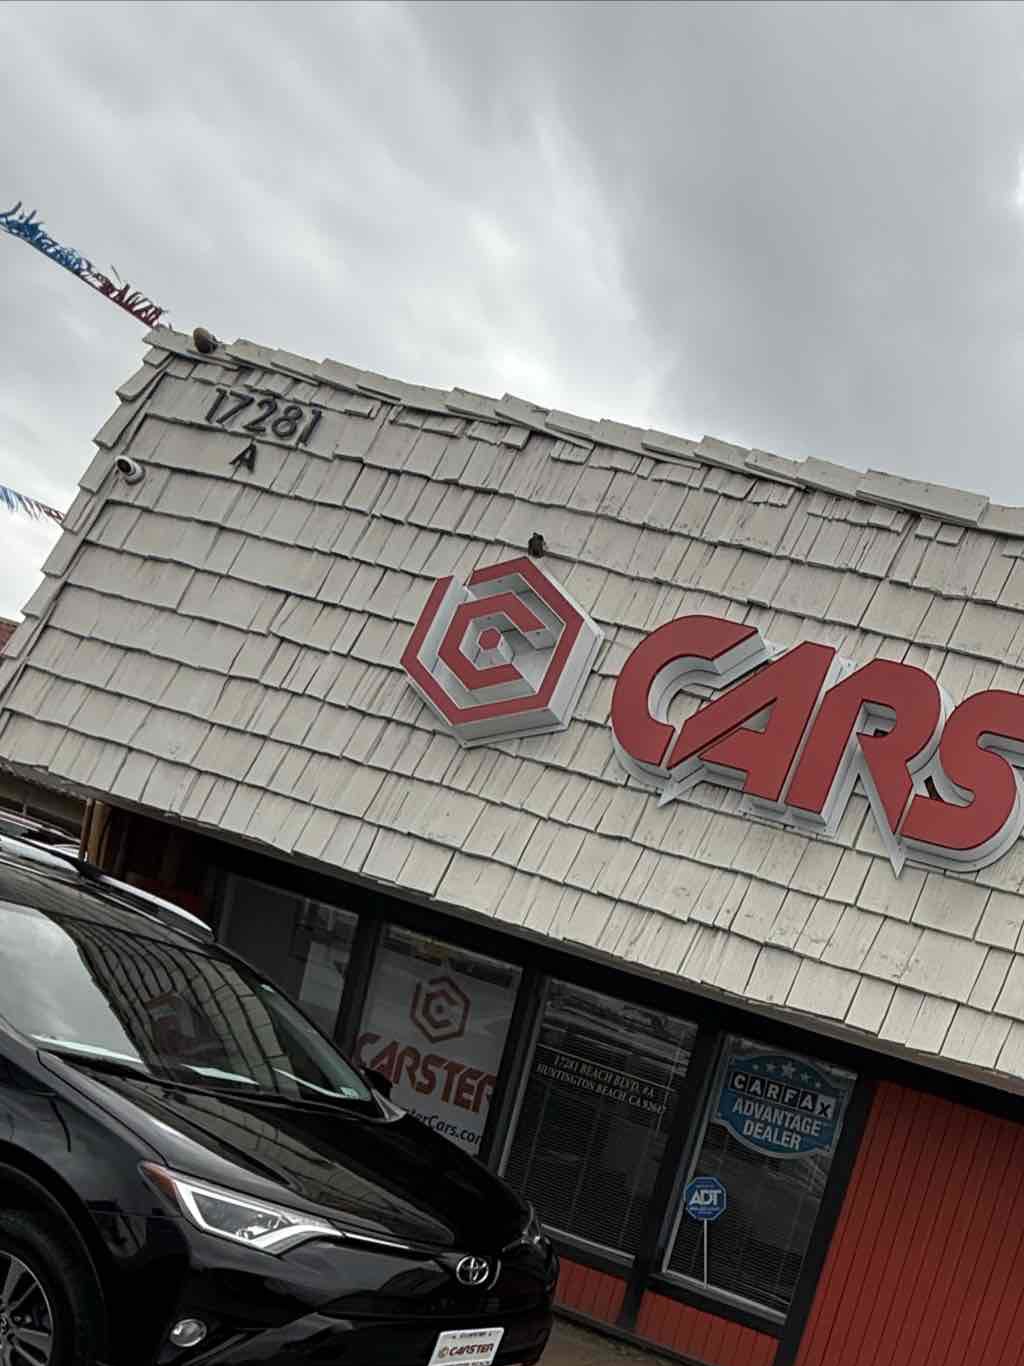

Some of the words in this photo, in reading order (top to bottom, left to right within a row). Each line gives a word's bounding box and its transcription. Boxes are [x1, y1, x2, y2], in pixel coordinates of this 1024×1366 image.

[205, 387, 322, 446] 17281
[229, 442, 257, 473] A
[733, 1073, 833, 1119] CARFAX
[732, 1097, 821, 1137] ADVANTAGE
[743, 1119, 801, 1151] DEALER
[688, 1189, 722, 1206] ADT
